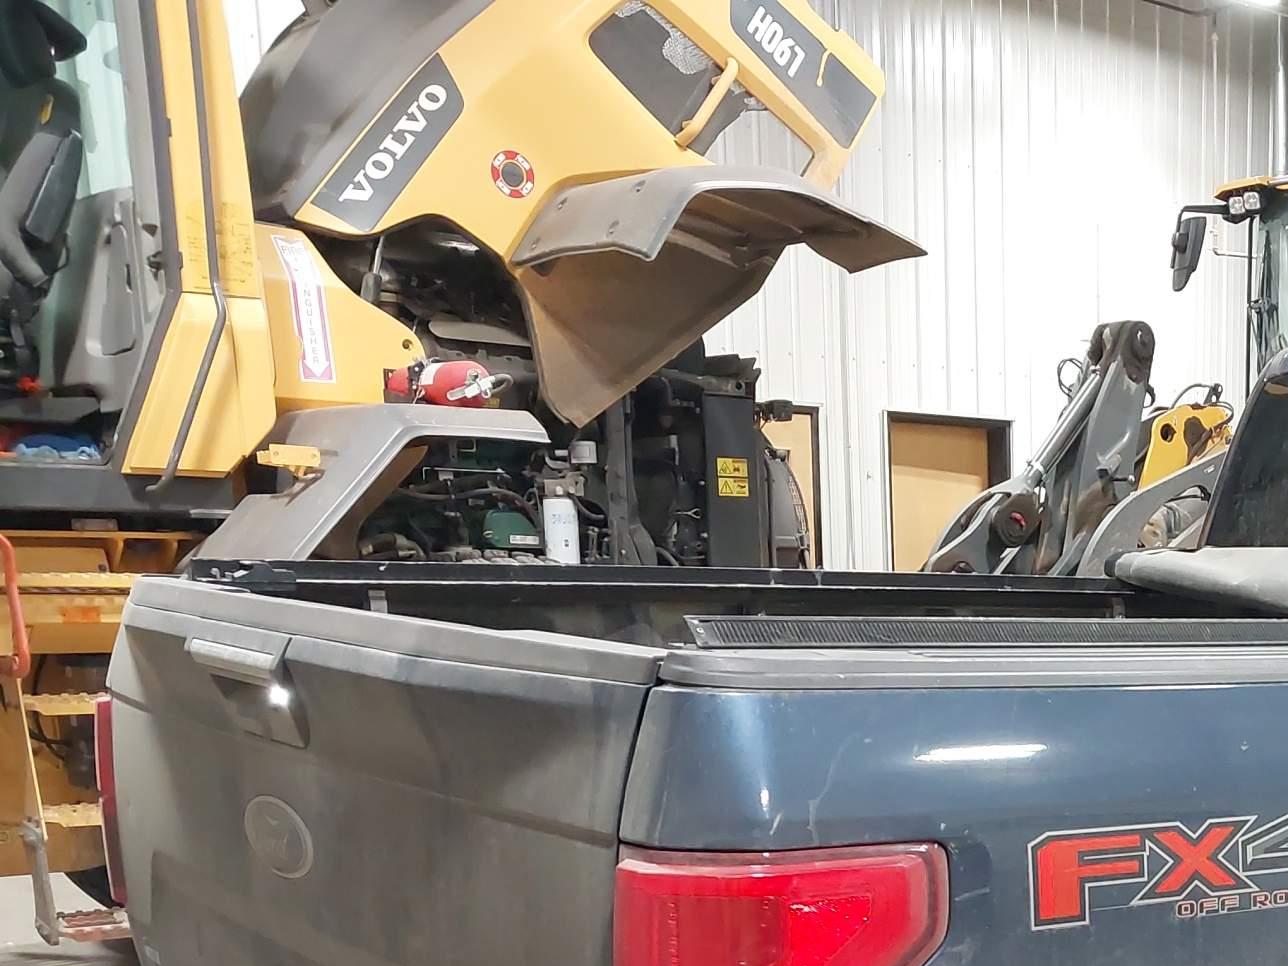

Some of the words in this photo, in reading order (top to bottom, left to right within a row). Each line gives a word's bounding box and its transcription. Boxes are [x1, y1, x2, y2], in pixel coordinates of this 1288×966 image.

[338, 84, 448, 202] VOLVO
[281, 245, 304, 256] FIRE
[1175, 894, 1240, 918] OFF
